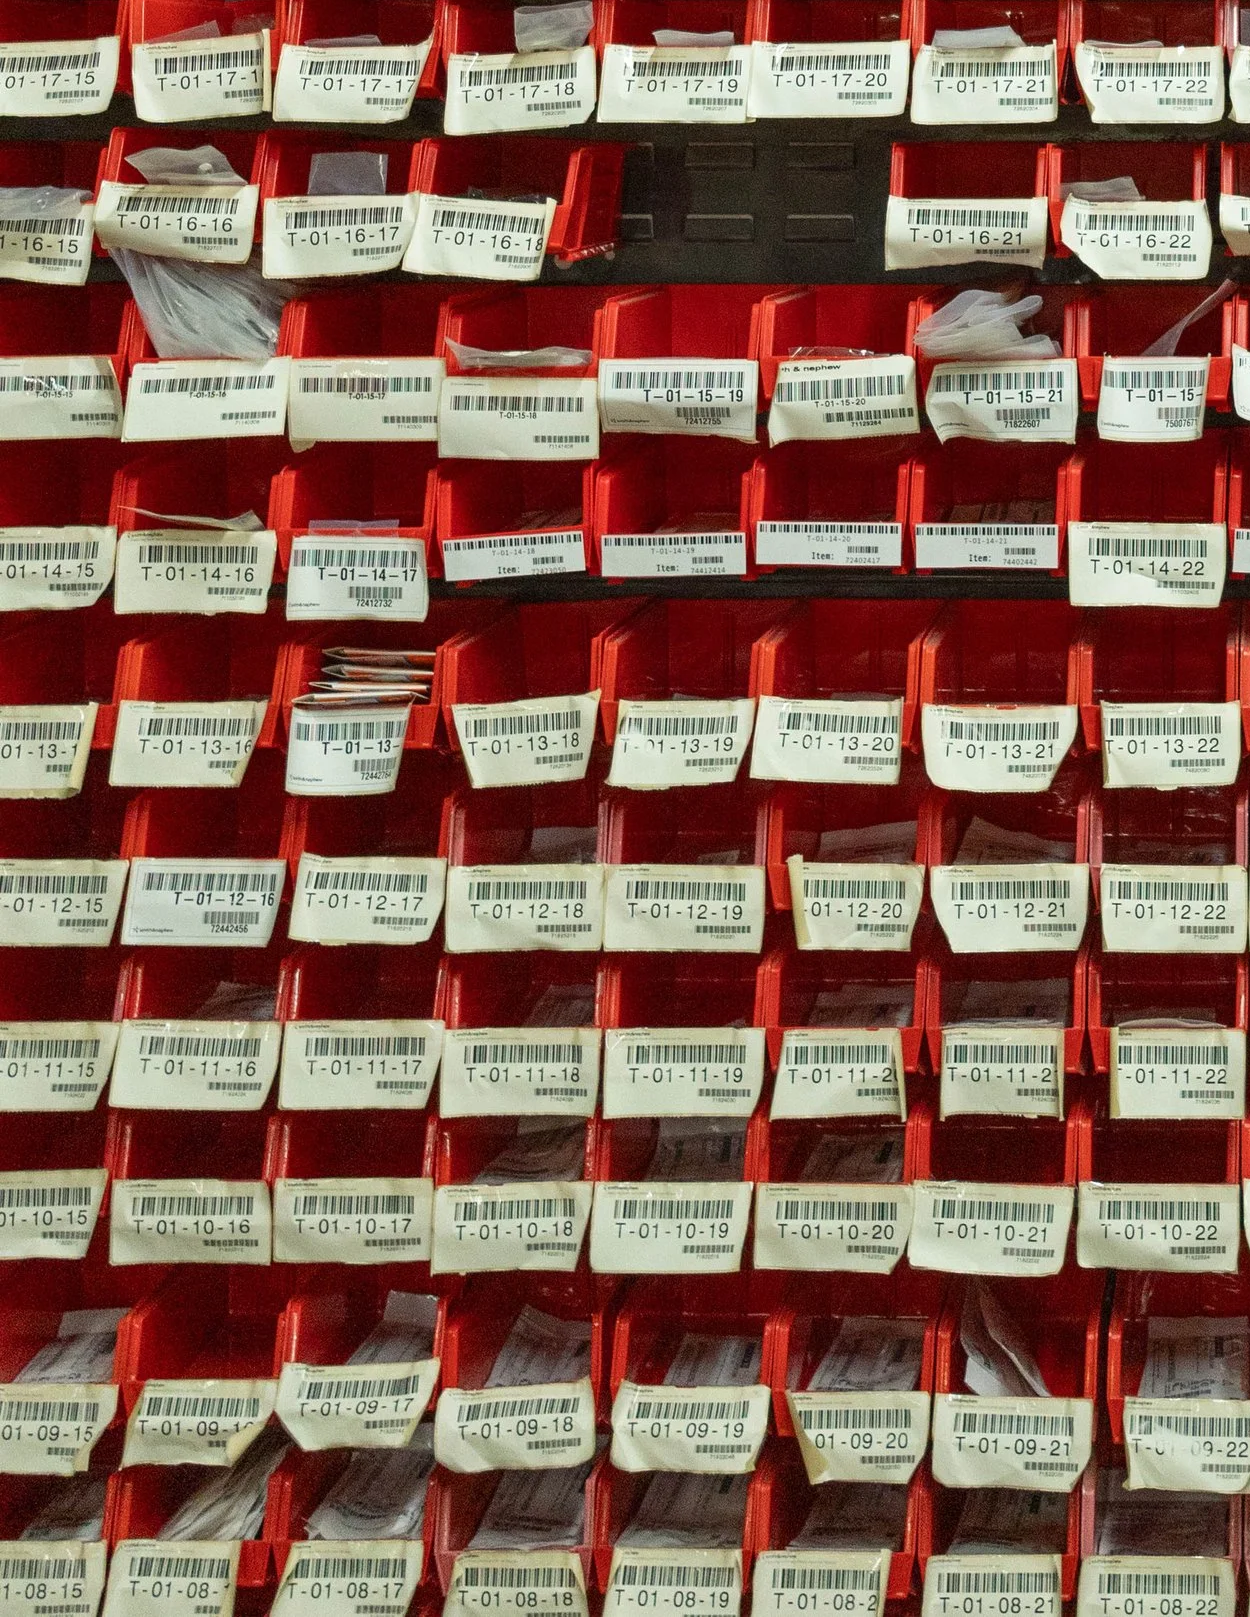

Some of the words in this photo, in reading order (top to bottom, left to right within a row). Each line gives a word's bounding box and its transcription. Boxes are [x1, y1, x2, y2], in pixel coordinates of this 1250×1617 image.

[300, 77, 416, 93] T-01-17-17
[625, 78, 738, 93] T-01-17-19
[773, 72, 887, 88] T-01-17-20
[933, 79, 1046, 94] T-01-17-21
[1093, 78, 1208, 94] T-01-17-22
[461, 82, 575, 103] T-01-17-18
[117, 214, 233, 233] T-01-16-16
[288, 226, 400, 247] T-01-16-17
[432, 228, 543, 251] T-01-16-18
[909, 228, 1024, 246] T-01-16-21
[188, 390, 227, 399] T-01-15-16
[348, 392, 385, 401] T-01-15-17
[643, 388, 744, 403] T-01-15-19
[963, 389, 1064, 404] T-01-15-21
[814, 398, 866, 408] T-01-15-20
[499, 411, 537, 420] T-01-15-18
[684, 416, 722, 426] 72412755
[1004, 419, 1041, 428] 71822607
[141, 566, 255, 583] T-01-14-16
[318, 567, 417, 582] T-01-14-17
[1090, 558, 1205, 576] T-01-14-22
[356, 599, 393, 608] 72412732
[468, 733, 580, 756] T-01-13-18
[778, 733, 894, 751] T-01-13-20
[1105, 738, 1220, 753] T-01-13-22
[944, 743, 1056, 759] T-01-13-21
[174, 892, 275, 906] T-01-12-16
[305, 892, 423, 912] T-01-12-17
[470, 903, 584, 919] T-01-12-18
[628, 903, 743, 920] T-01-12-19
[952, 903, 1067, 919] T-01-12-21
[1112, 903, 1226, 920] T-01-12-22
[210, 925, 248, 934] 72442456
[140, 1059, 256, 1076] T-01-11-16
[306, 1060, 422, 1075] T-01-11-17
[466, 1067, 580, 1083] T-01-11-18
[628, 1067, 744, 1083] T-01-11-19
[133, 1219, 250, 1235] T-01-10-16
[295, 1219, 412, 1234] T-01-10-17
[455, 1221, 573, 1240] T-01-10-18
[615, 1222, 729, 1239] T-01-10-19
[778, 1224, 894, 1240] T-01-10-20
[933, 1222, 1048, 1242] T-01-10-21
[1101, 1223, 1217, 1241] T-01-10-22
[458, 1416, 573, 1440] T-01-09-18
[628, 1422, 744, 1438] T-01-09-19
[458, 1590, 573, 1607] T-01-08-18
[615, 1591, 730, 1608] T-01-08-19
[939, 1597, 1055, 1614] T-01-08-21
[1101, 1599, 1218, 1616] T-01-08-22
